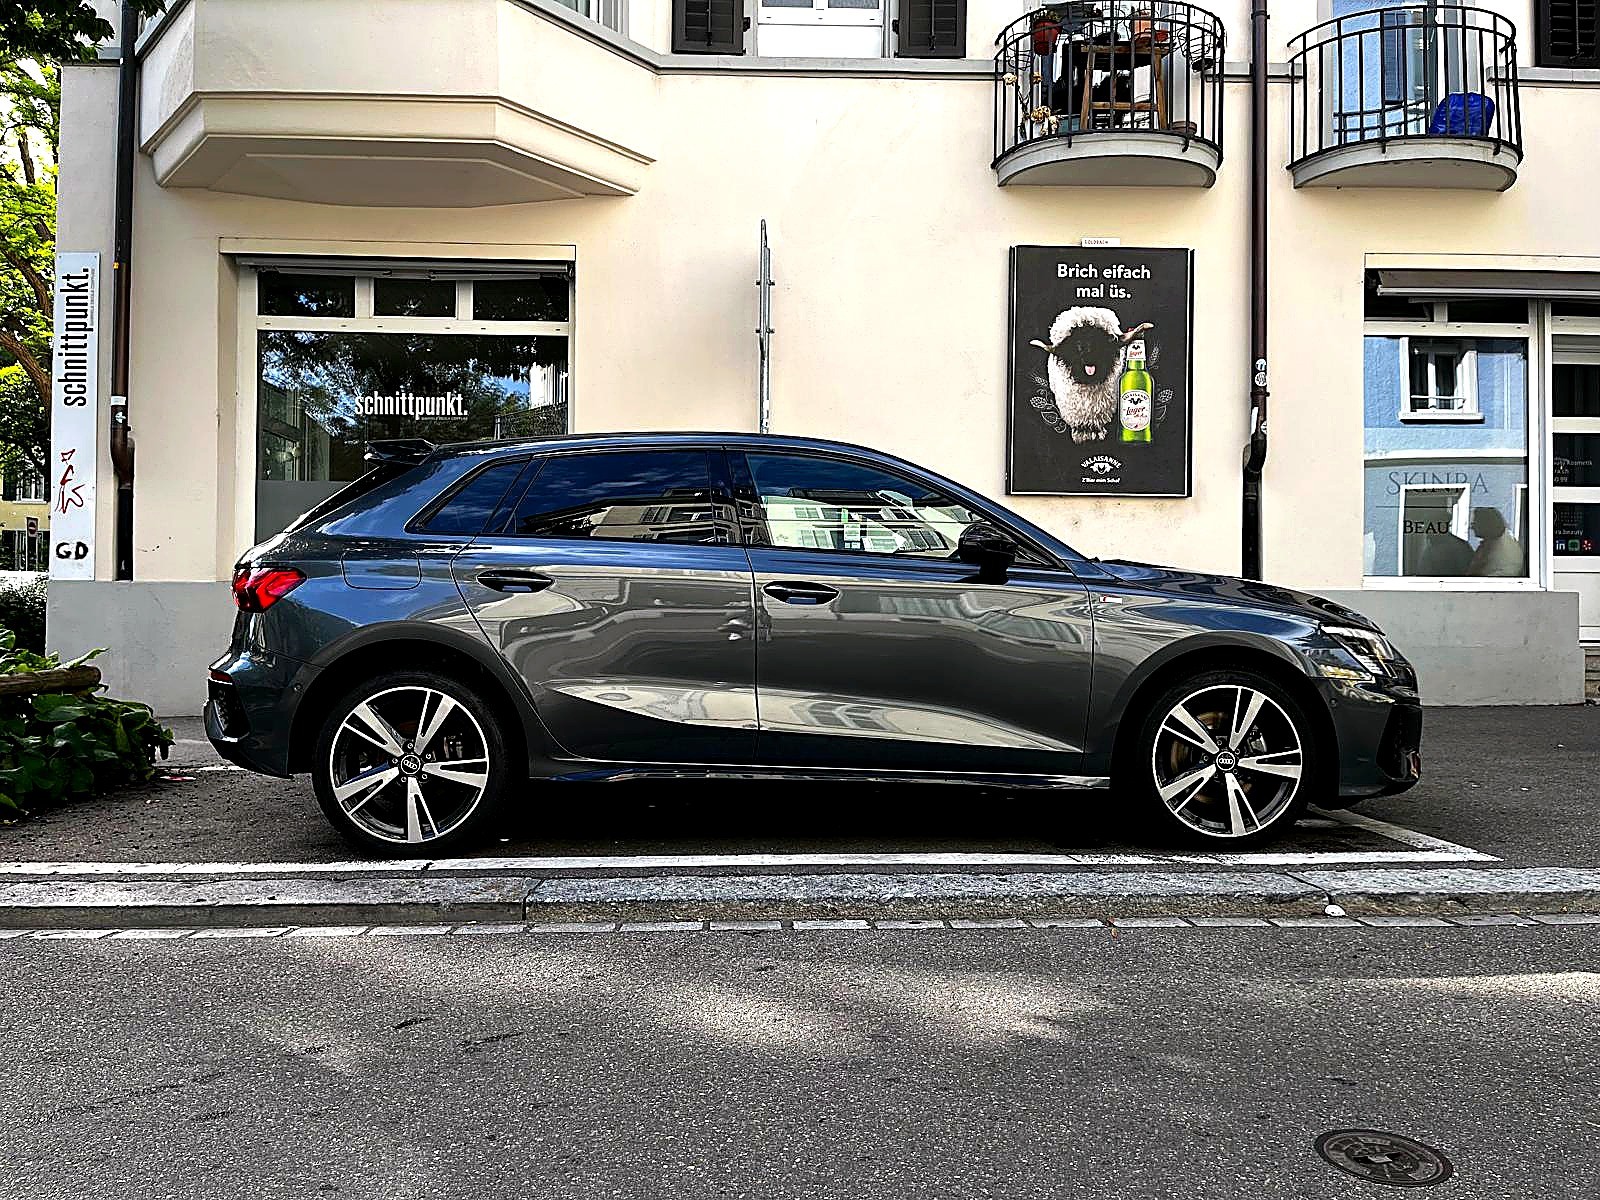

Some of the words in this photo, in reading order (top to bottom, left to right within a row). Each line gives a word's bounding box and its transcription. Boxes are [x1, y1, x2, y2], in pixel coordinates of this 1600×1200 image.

[1057, 263, 1098, 278] Brich
[1102, 264, 1151, 279] eifach
[1076, 283, 1104, 298] mal
[1109, 284, 1132, 299] üs.
[58, 268, 93, 407] schnittpunkt.
[355, 391, 469, 420] schnittpunkt.
[1080, 455, 1122, 469] VALAISANNE
